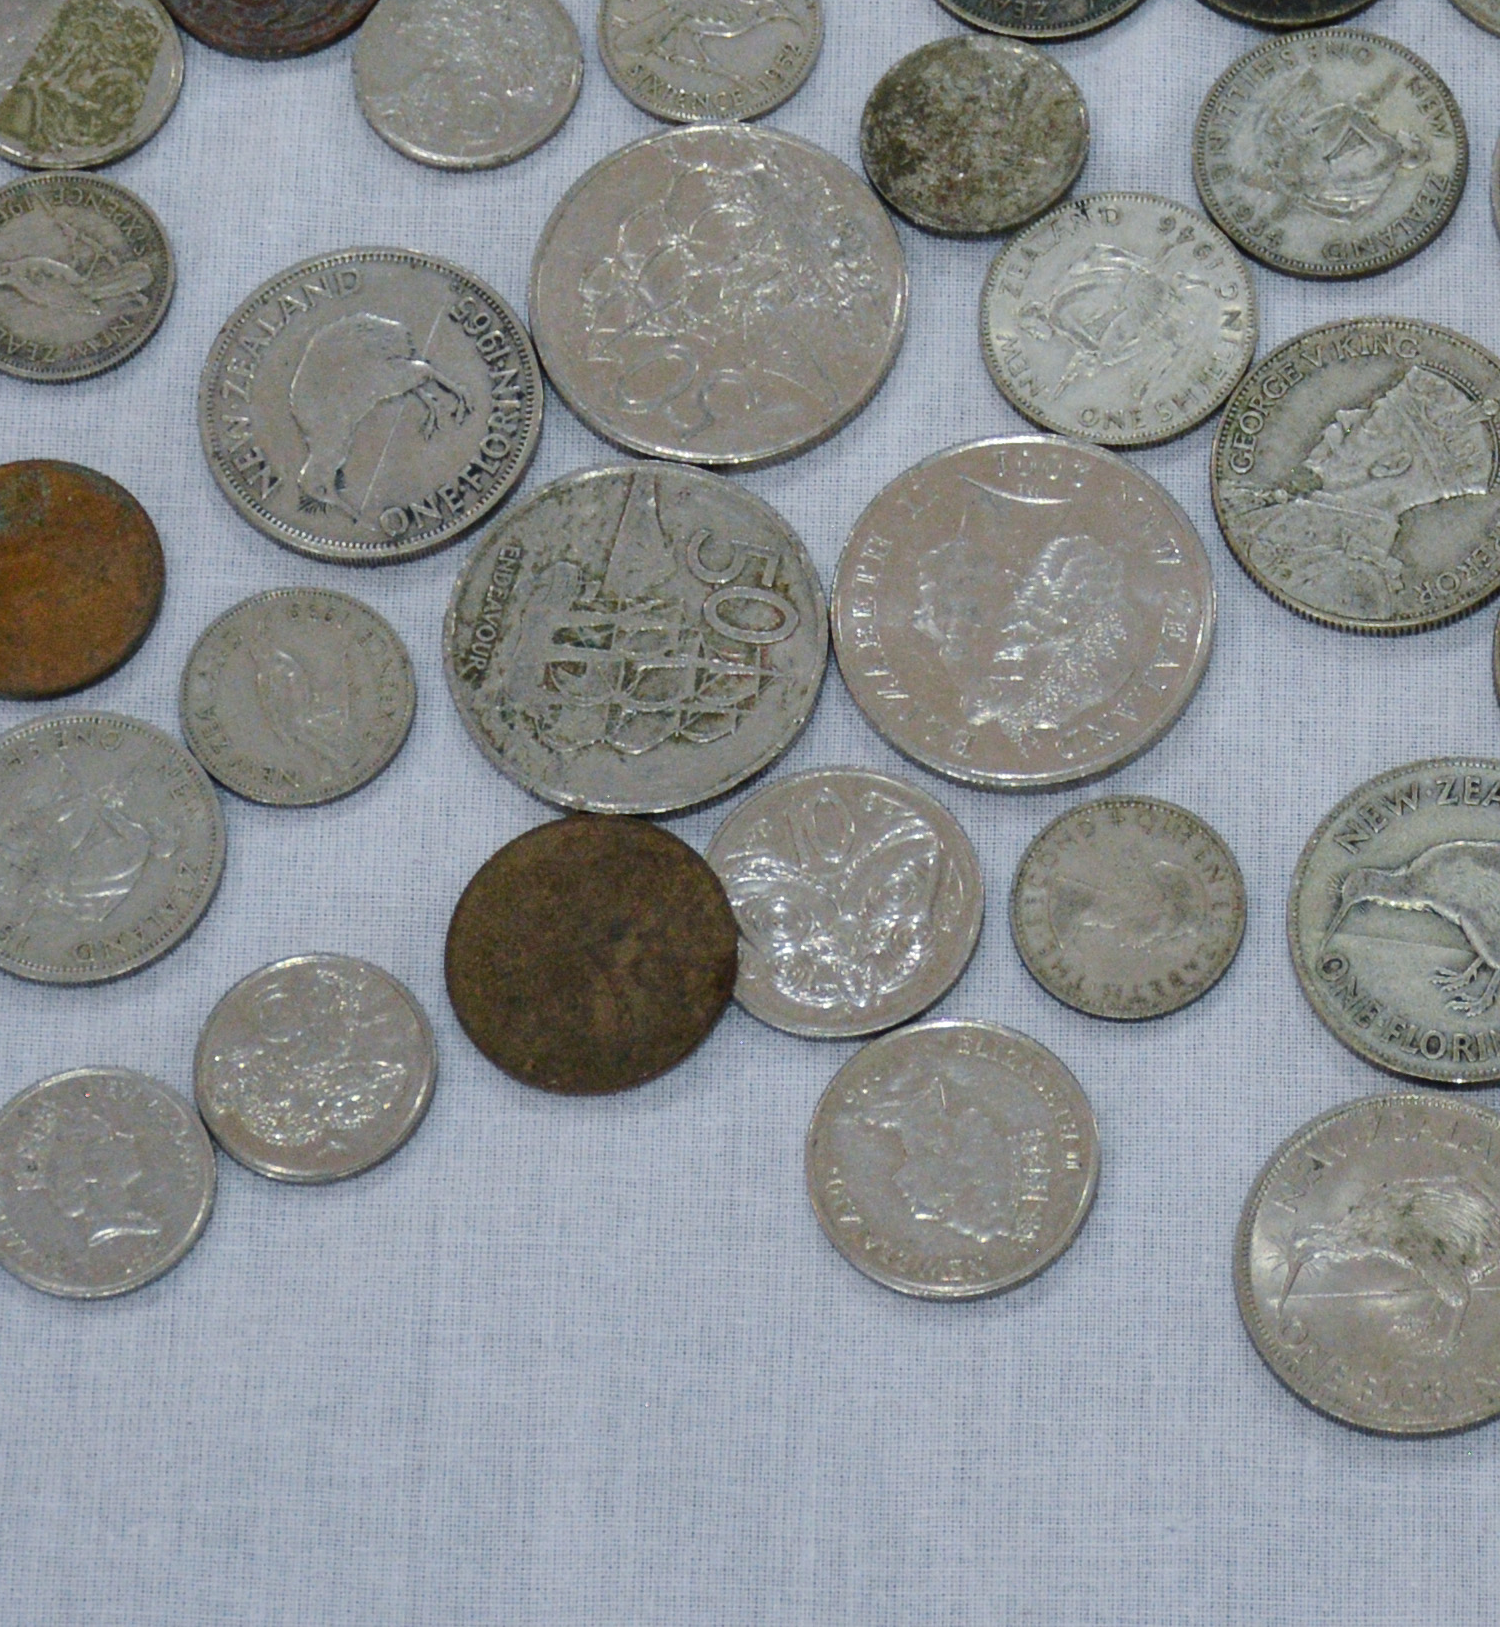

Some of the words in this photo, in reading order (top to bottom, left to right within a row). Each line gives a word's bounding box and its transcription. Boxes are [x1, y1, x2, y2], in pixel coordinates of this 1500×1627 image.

[1402, 73, 1452, 141] NEW
[1318, 170, 1452, 267] ZEALAND
[68, 317, 134, 361] NEW
[222, 267, 361, 408] ZEALAND
[446, 293, 508, 370] 1965
[466, 370, 526, 489] FLORIN
[1077, 403, 1150, 435] ONE
[1230, 361, 1304, 477] GEORGE
[1303, 343, 1328, 372] V
[1340, 329, 1424, 362] KING
[238, 410, 284, 503] NEW
[376, 476, 468, 541] ONE
[466, 542, 524, 680] ENDEAVOUR
[684, 526, 802, 648] 50
[783, 788, 856, 872] 10
[1333, 782, 1423, 857] NEW
[1321, 954, 1390, 1040] ONE
